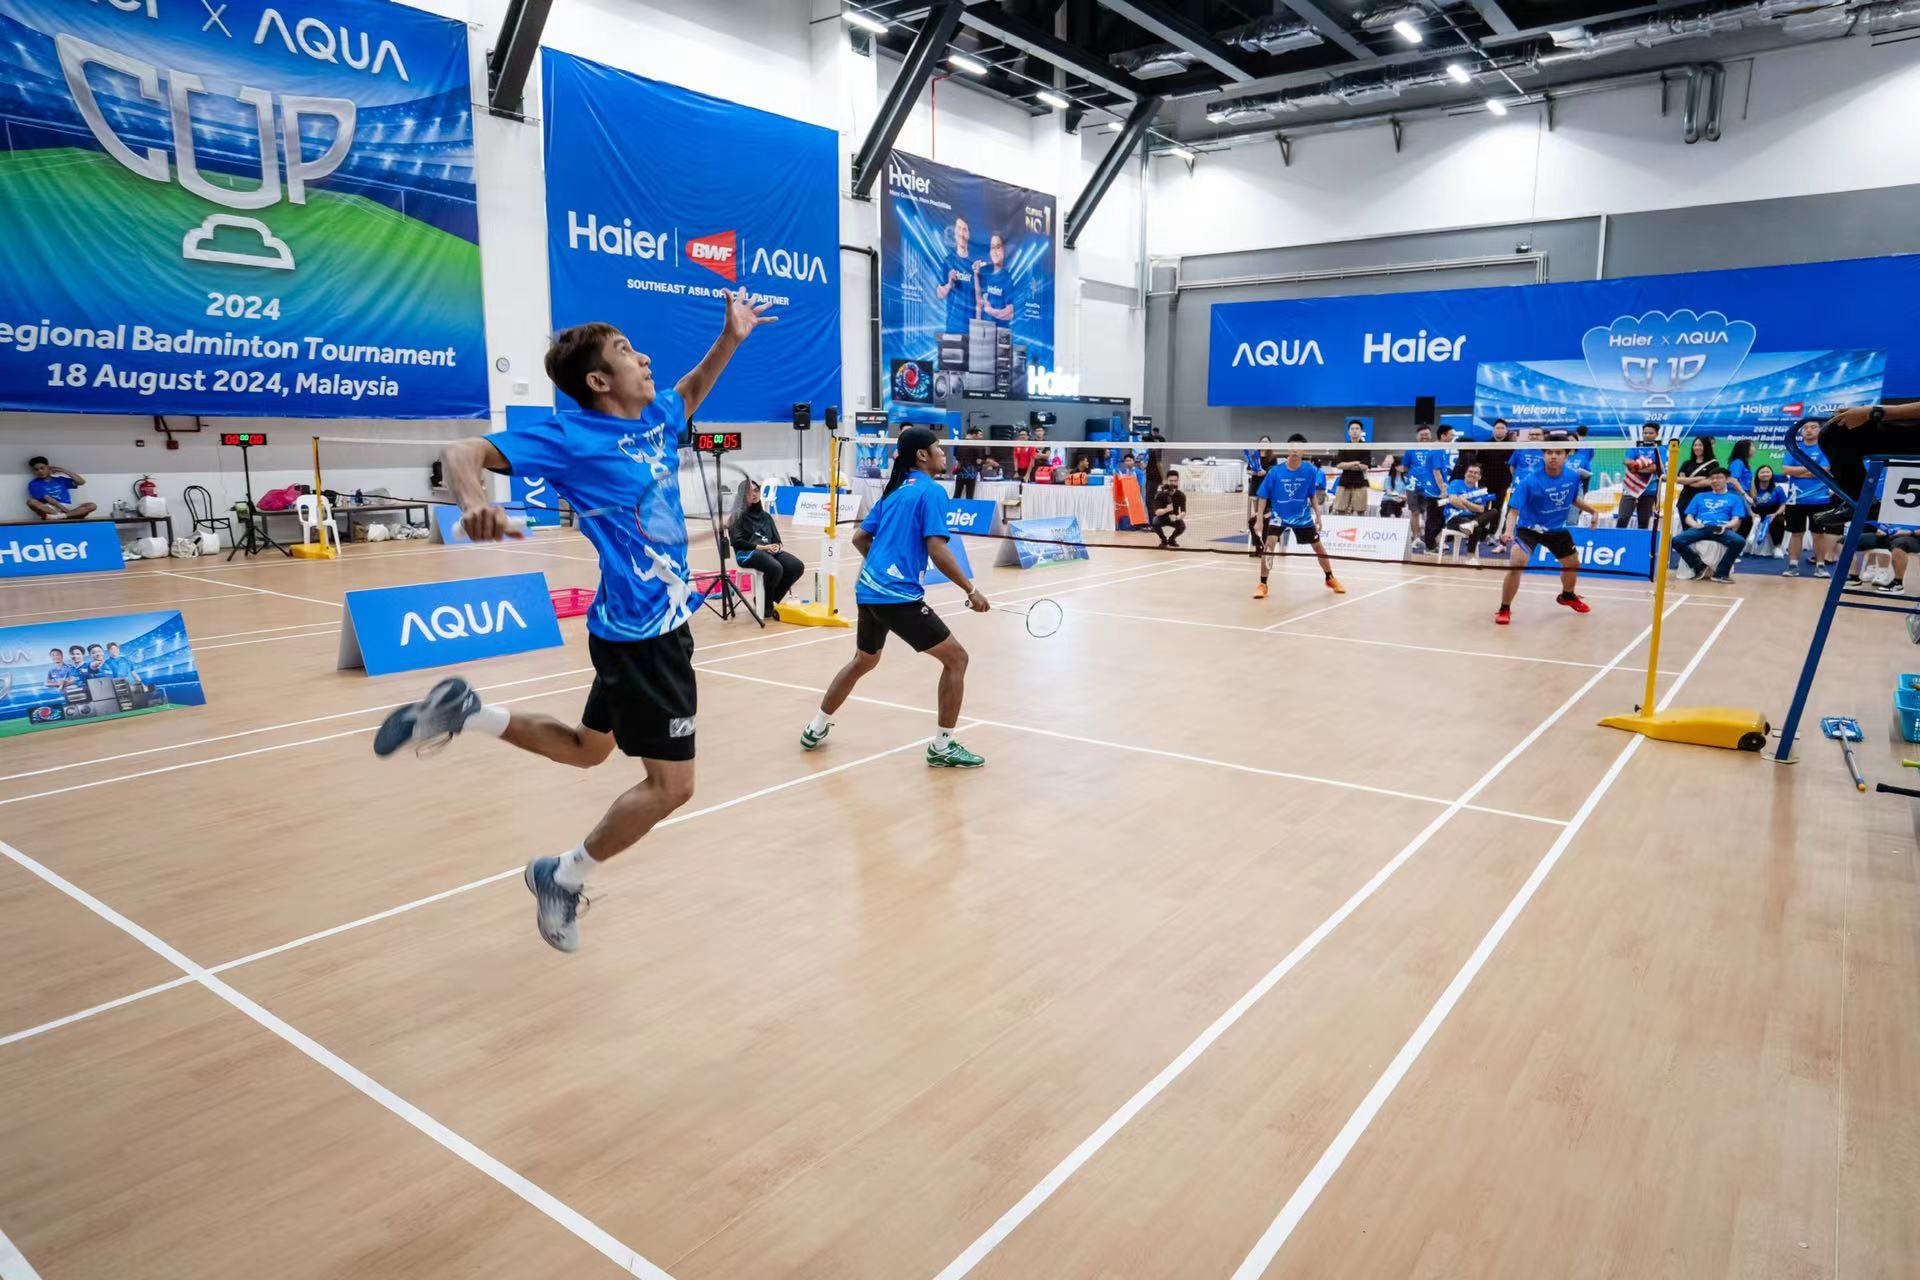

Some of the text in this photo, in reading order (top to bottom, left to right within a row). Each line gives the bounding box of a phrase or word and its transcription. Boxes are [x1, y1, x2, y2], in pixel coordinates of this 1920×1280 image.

[254, 8, 409, 82] AQUA
[53, 32, 357, 211] CUP
[889, 164, 930, 194] Haier
[568, 210, 828, 284] Haier BWF AQUA
[627, 278, 686, 295] SOUTHEAST
[688, 286, 710, 298] ASIA
[206, 292, 281, 321] 2024
[0, 319, 456, 367] egional Badminton Tournament
[1231, 329, 1467, 367] AQUA Haier
[1609, 334, 1653, 347] Haier
[1675, 331, 1728, 345] AQUA
[47, 362, 398, 400] 18 August 2024, Malaysia
[1028, 364, 1080, 397] Haier
[1511, 404, 1568, 415] Welcome
[1645, 412, 1669, 421] 2024
[1740, 403, 1774, 414] Haier
[698, 434, 738, 449] 06 00 05
[1754, 425, 1773, 433] 2024
[1894, 478, 1920, 508] 5
[946, 508, 977, 526] aier
[0, 538, 88, 564] Haier
[1363, 531, 1398, 542] AQUA
[401, 599, 528, 647] AQUA
